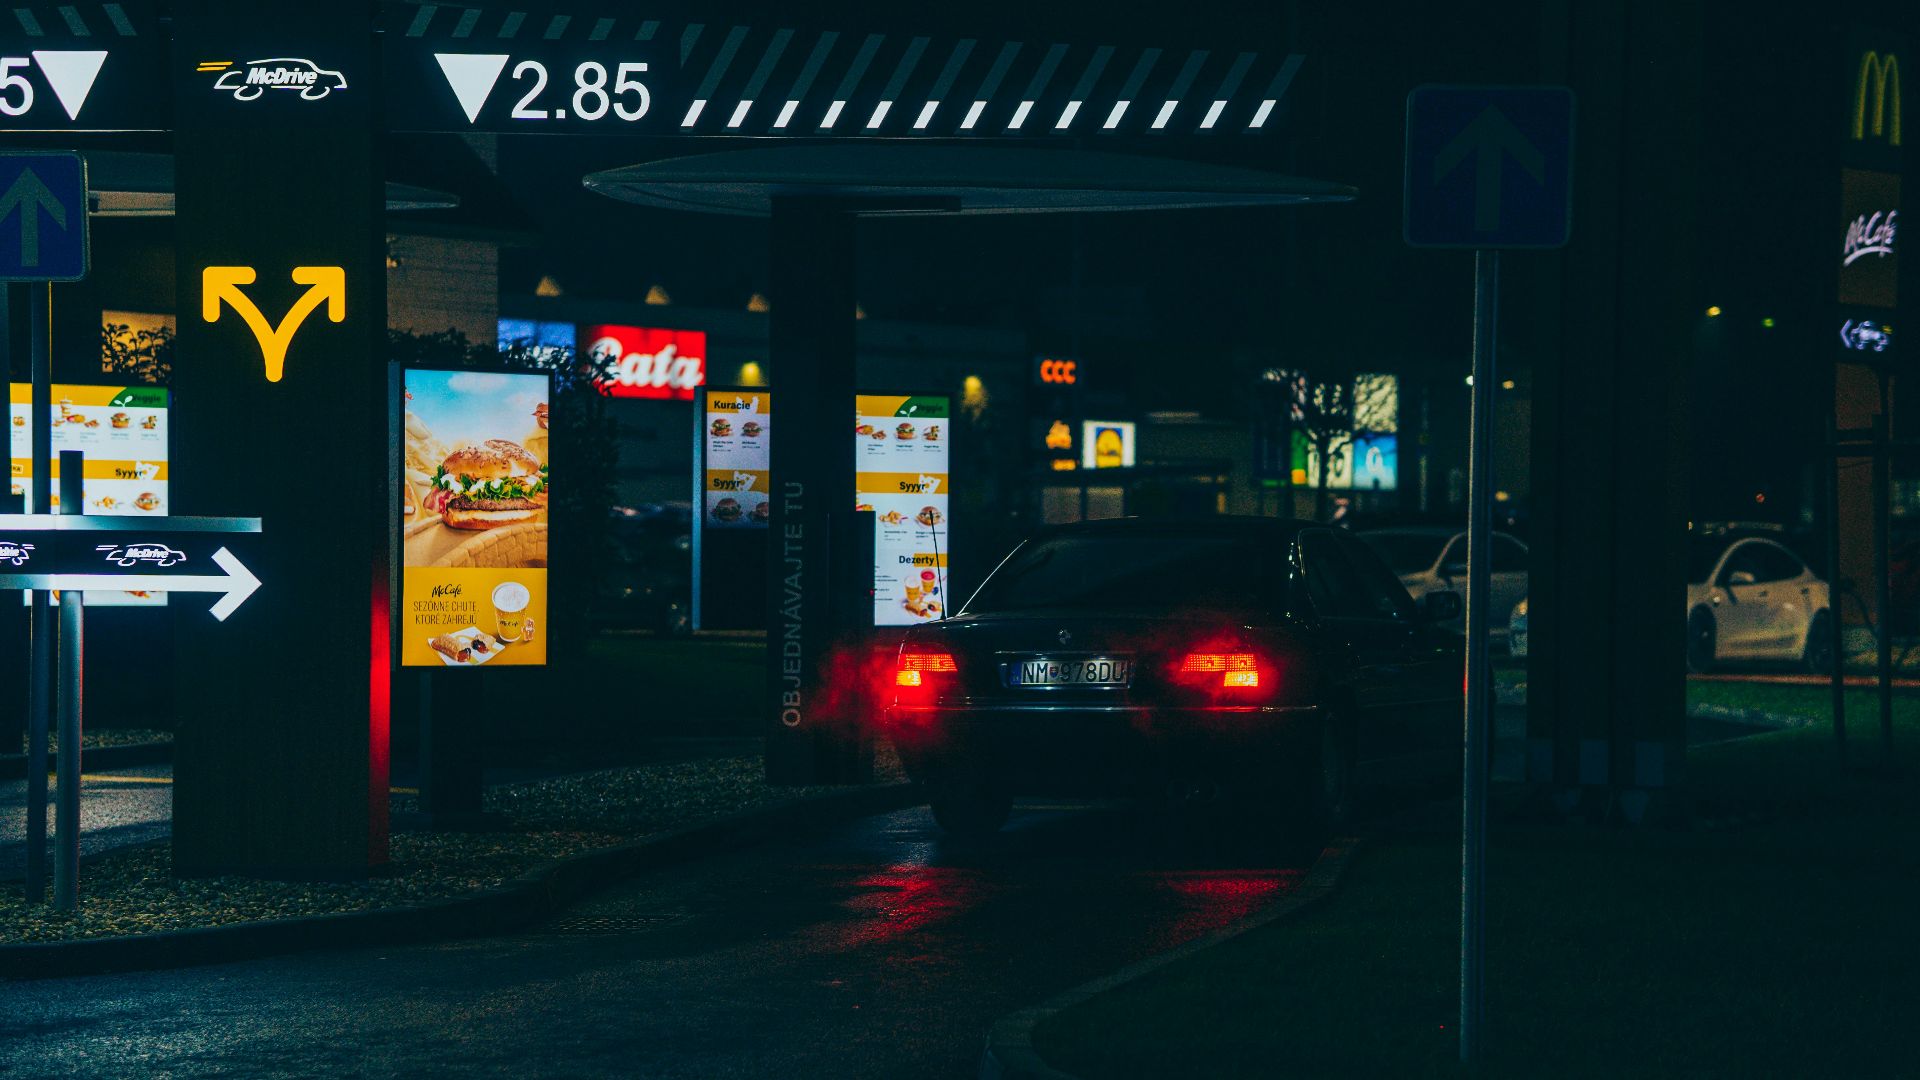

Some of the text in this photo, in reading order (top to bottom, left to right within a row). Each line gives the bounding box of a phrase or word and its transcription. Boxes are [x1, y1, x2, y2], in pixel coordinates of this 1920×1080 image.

[246, 67, 317, 84] McDrive
[511, 60, 650, 121] 2.85
[1040, 359, 1076, 384] CCC
[714, 400, 750, 410] Kuracie
[713, 478, 741, 489] Syyyr
[899, 482, 925, 492] Syyyr
[125, 548, 169, 558] McDrive
[899, 555, 934, 566] Dezerty
[779, 482, 804, 728] OBJEDNÁVAJTE TU
